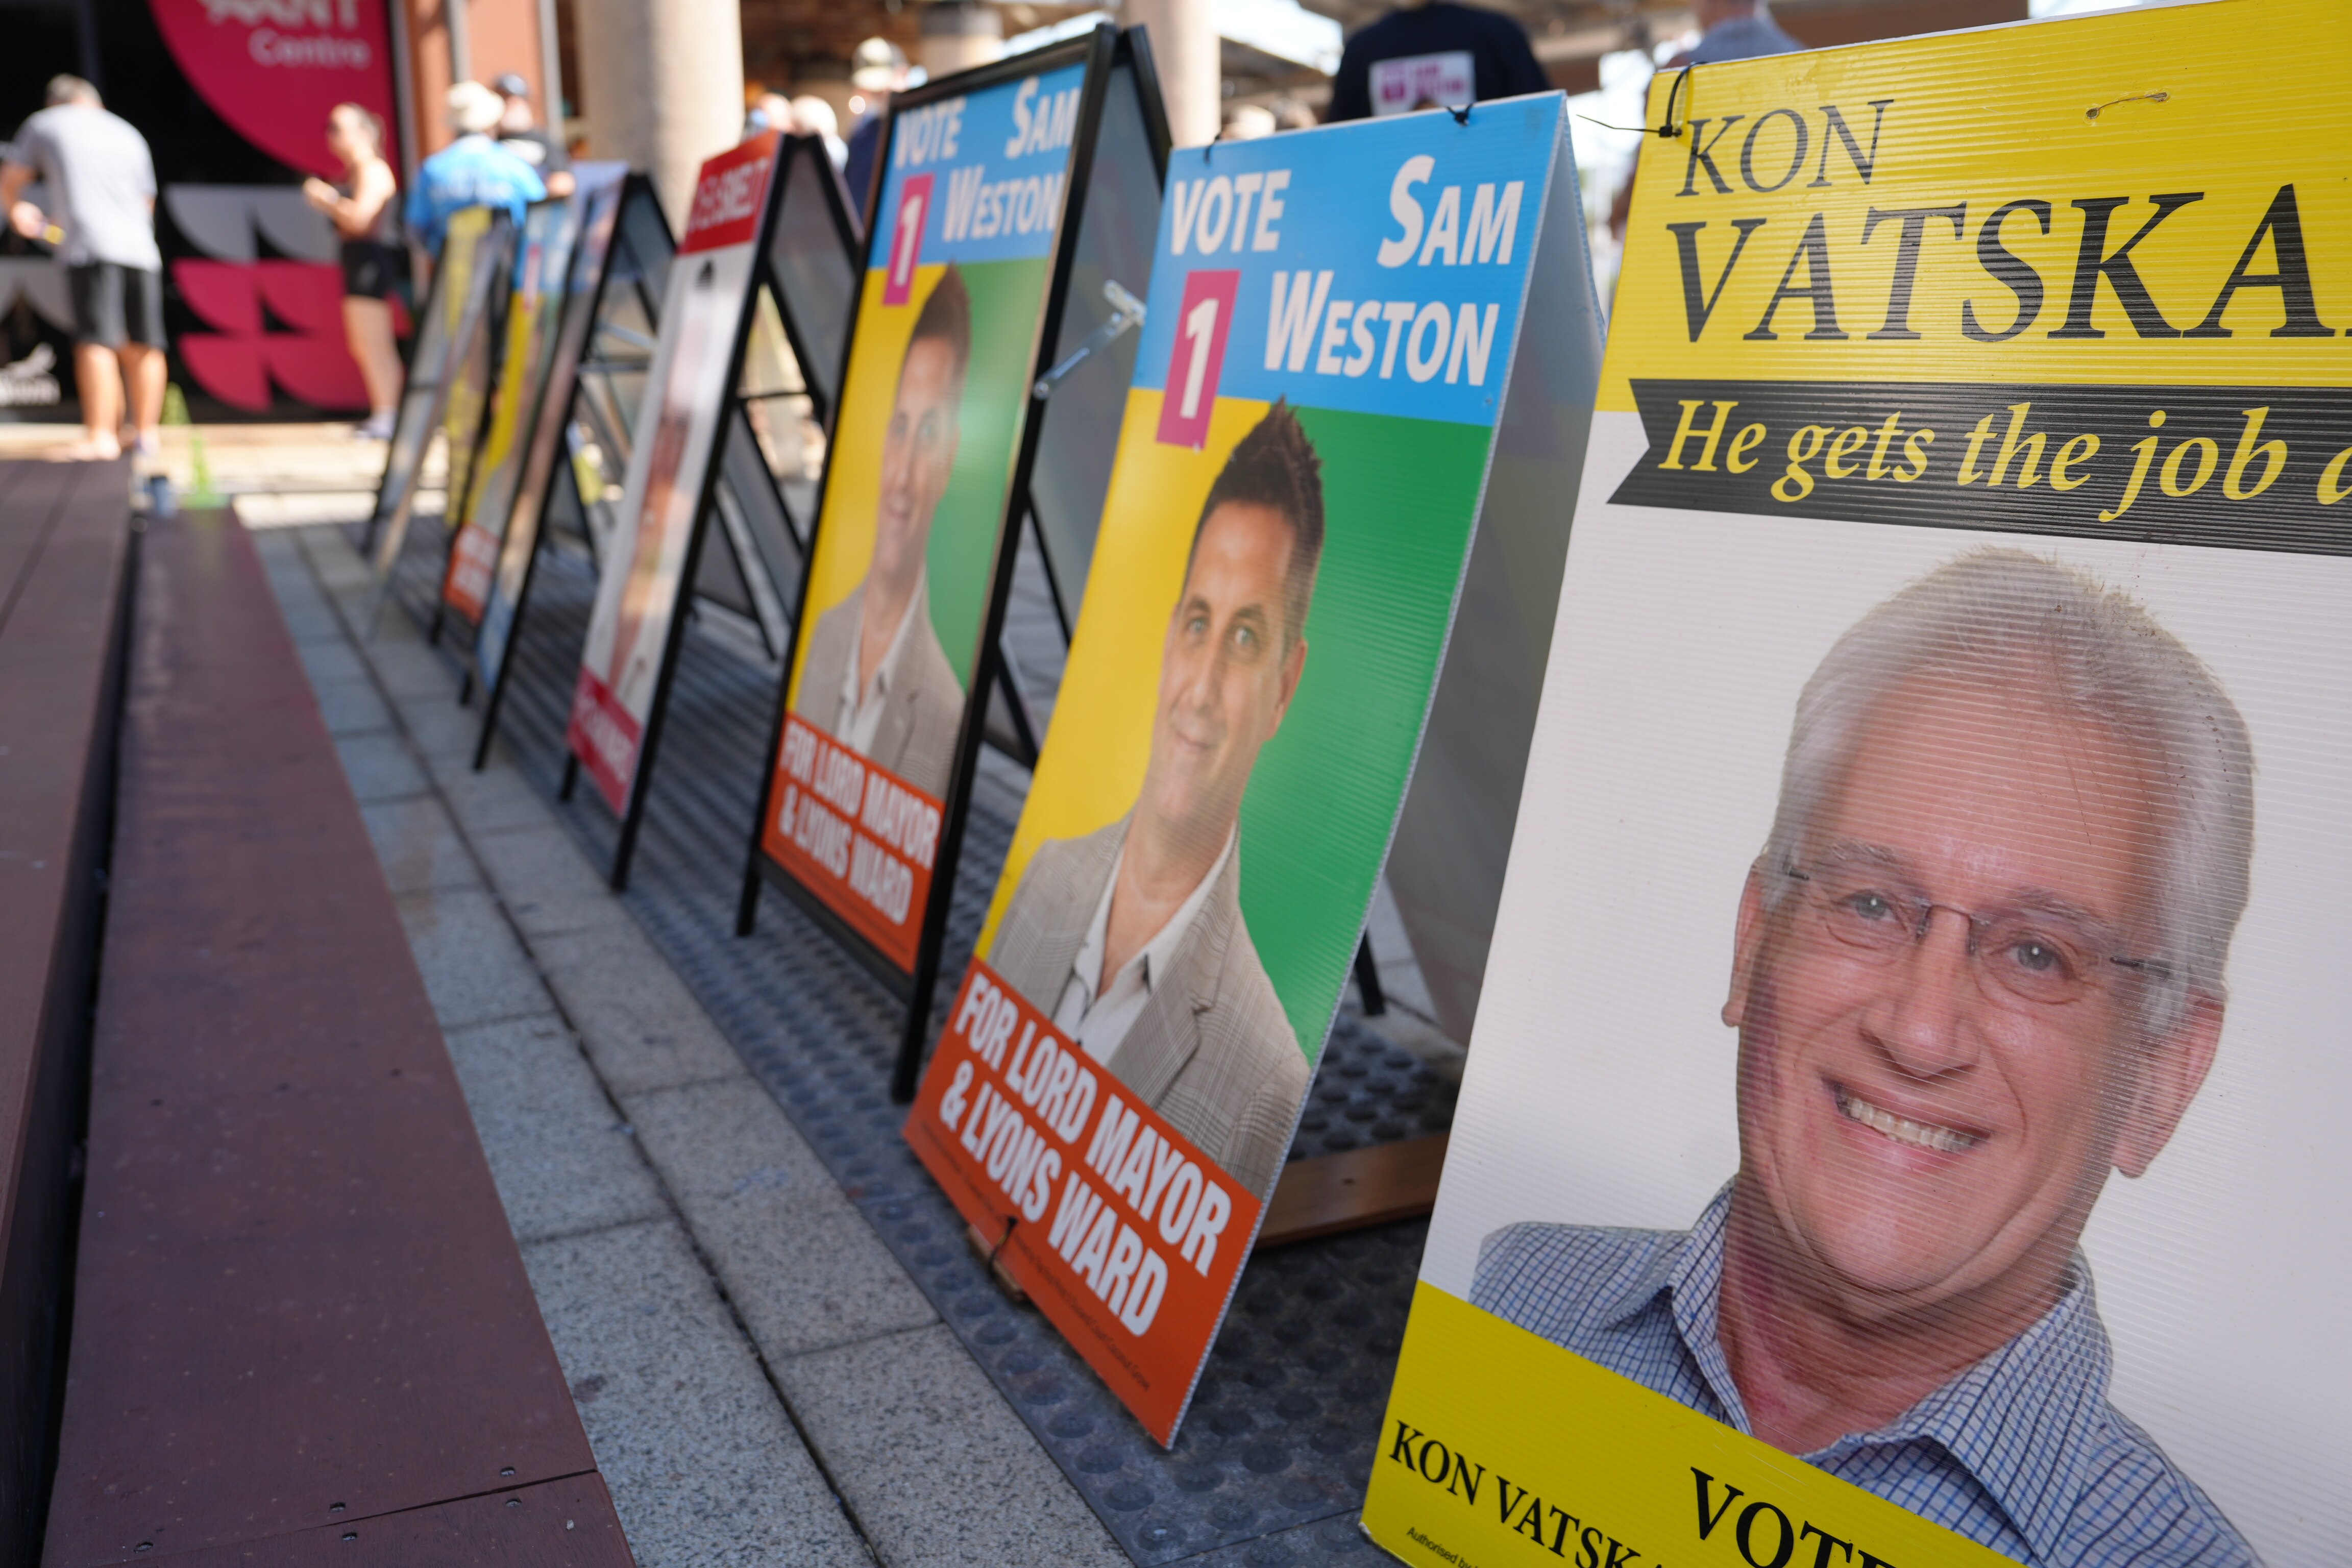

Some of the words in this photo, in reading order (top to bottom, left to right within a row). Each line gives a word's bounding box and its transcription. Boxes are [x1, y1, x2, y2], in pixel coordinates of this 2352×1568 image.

[895, 96, 967, 169] VOTE
[1005, 75, 1082, 160] SAM
[1676, 99, 1895, 197] KON
[894, 194, 923, 287] 1
[943, 165, 1066, 242] WESTON
[1171, 169, 1291, 255] VOTE
[1377, 155, 1524, 268] SAM
[1666, 183, 2352, 345] VATSKA
[1180, 298, 1219, 419] 1
[1264, 271, 1500, 386] WESTON
[1658, 399, 1767, 474] He
[1770, 411, 1935, 502] gets
[1956, 402, 2101, 491] the
[2098, 405, 2288, 523] job
[779, 719, 817, 786] FOR
[813, 740, 866, 818] LORD
[861, 770, 941, 871] MAYOR
[794, 793, 852, 879] LYONS
[848, 831, 914, 925] WARD
[954, 971, 1019, 1069] FOR
[1004, 1020, 1098, 1145] LORD
[1085, 1093, 1232, 1277] MAYOR
[939, 1060, 974, 1132] &
[960, 1081, 1062, 1223] LYONS
[1047, 1170, 1168, 1337] WARD
[1388, 1419, 1486, 1505] KON
[1496, 1475, 1665, 1568] VATSK
[1407, 1527, 1459, 1563] Authorised
[1690, 1466, 1898, 1568] VOT
